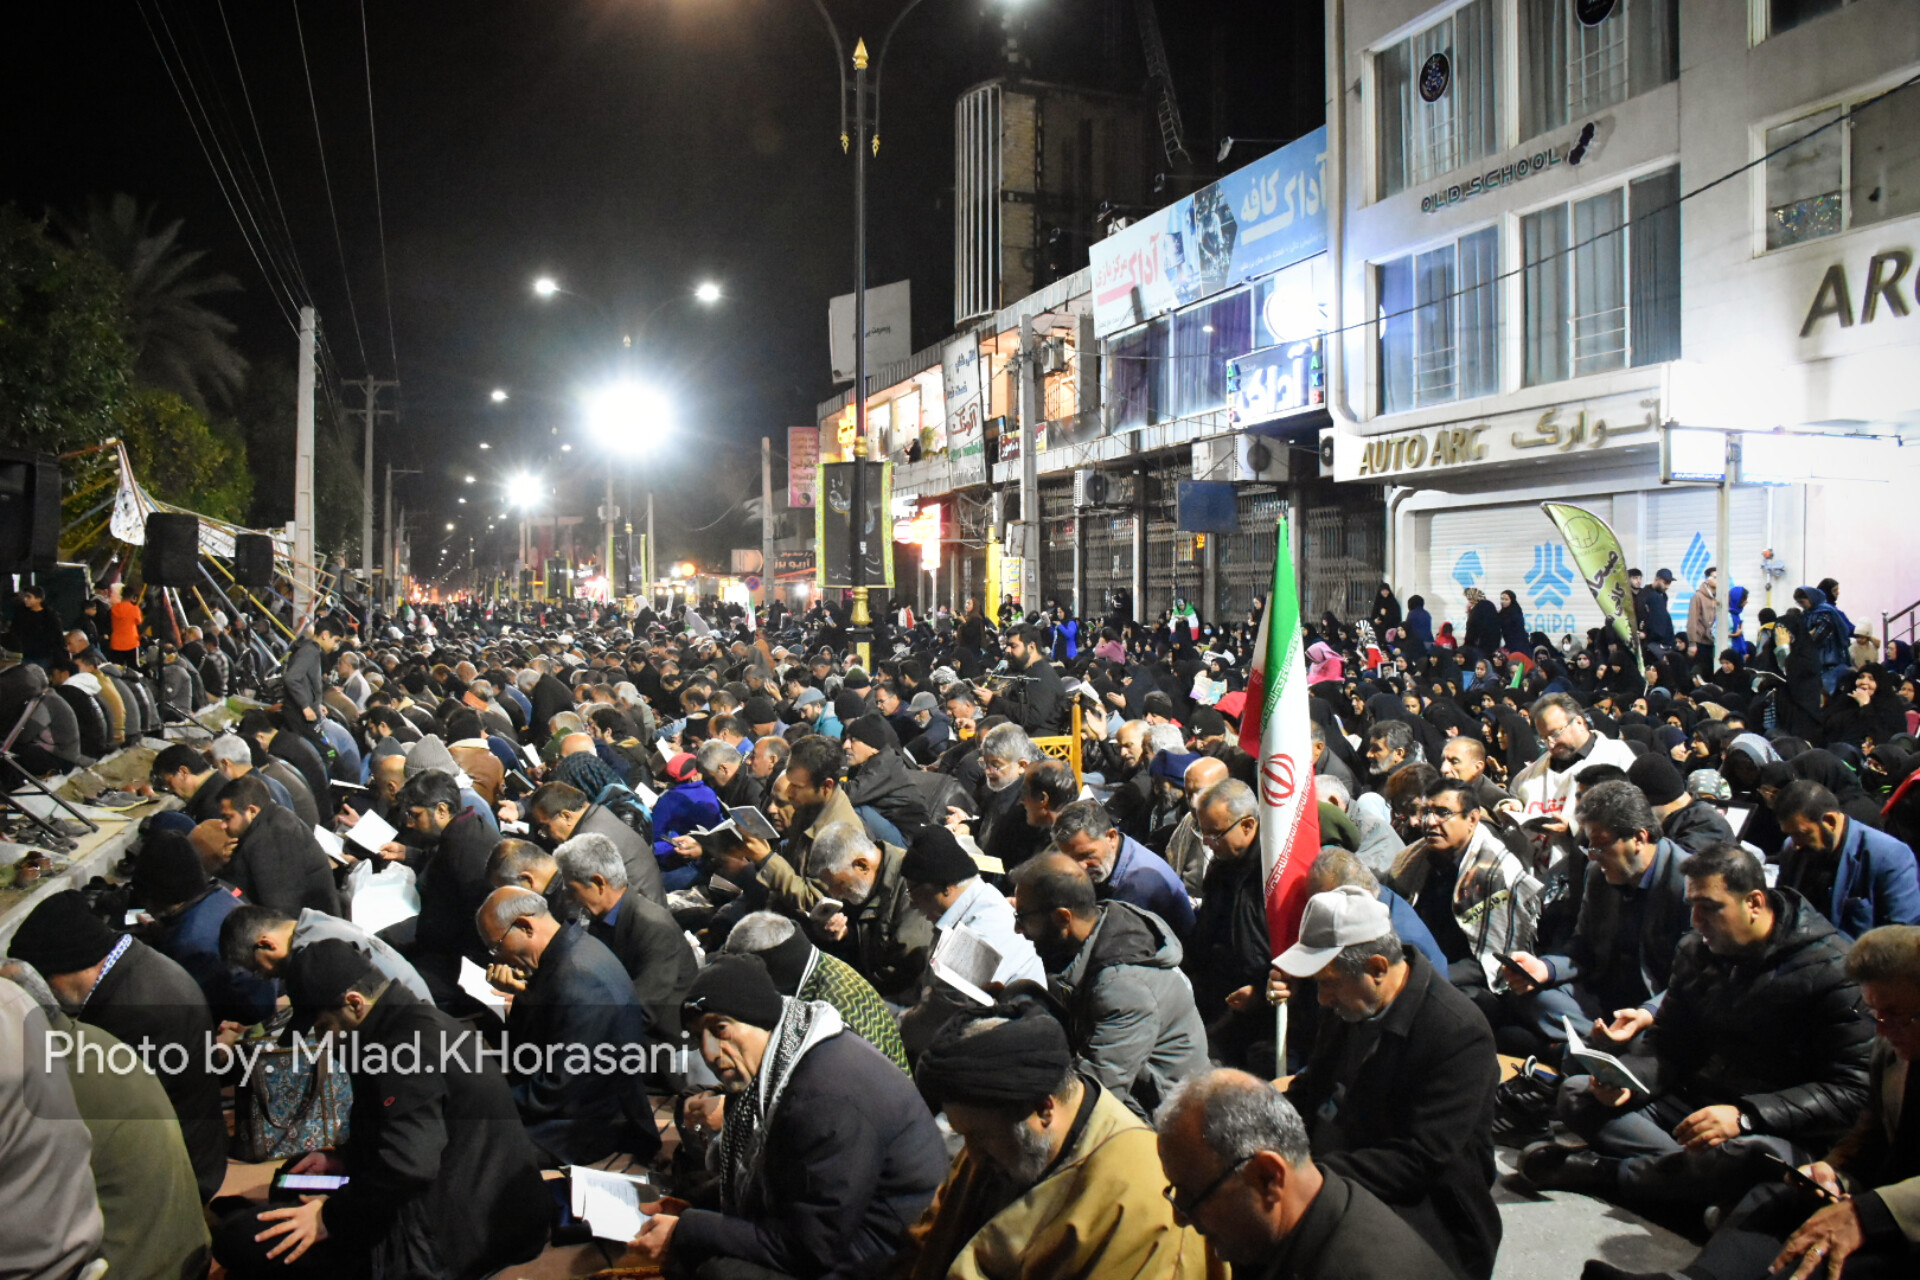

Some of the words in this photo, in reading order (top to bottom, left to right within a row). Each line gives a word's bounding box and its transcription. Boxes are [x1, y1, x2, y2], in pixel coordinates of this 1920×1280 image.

[1421, 184, 1461, 213] OLD
[1465, 148, 1562, 198] SCHOOL
[1359, 433, 1428, 475] AUTO
[1430, 424, 1491, 466] ARG
